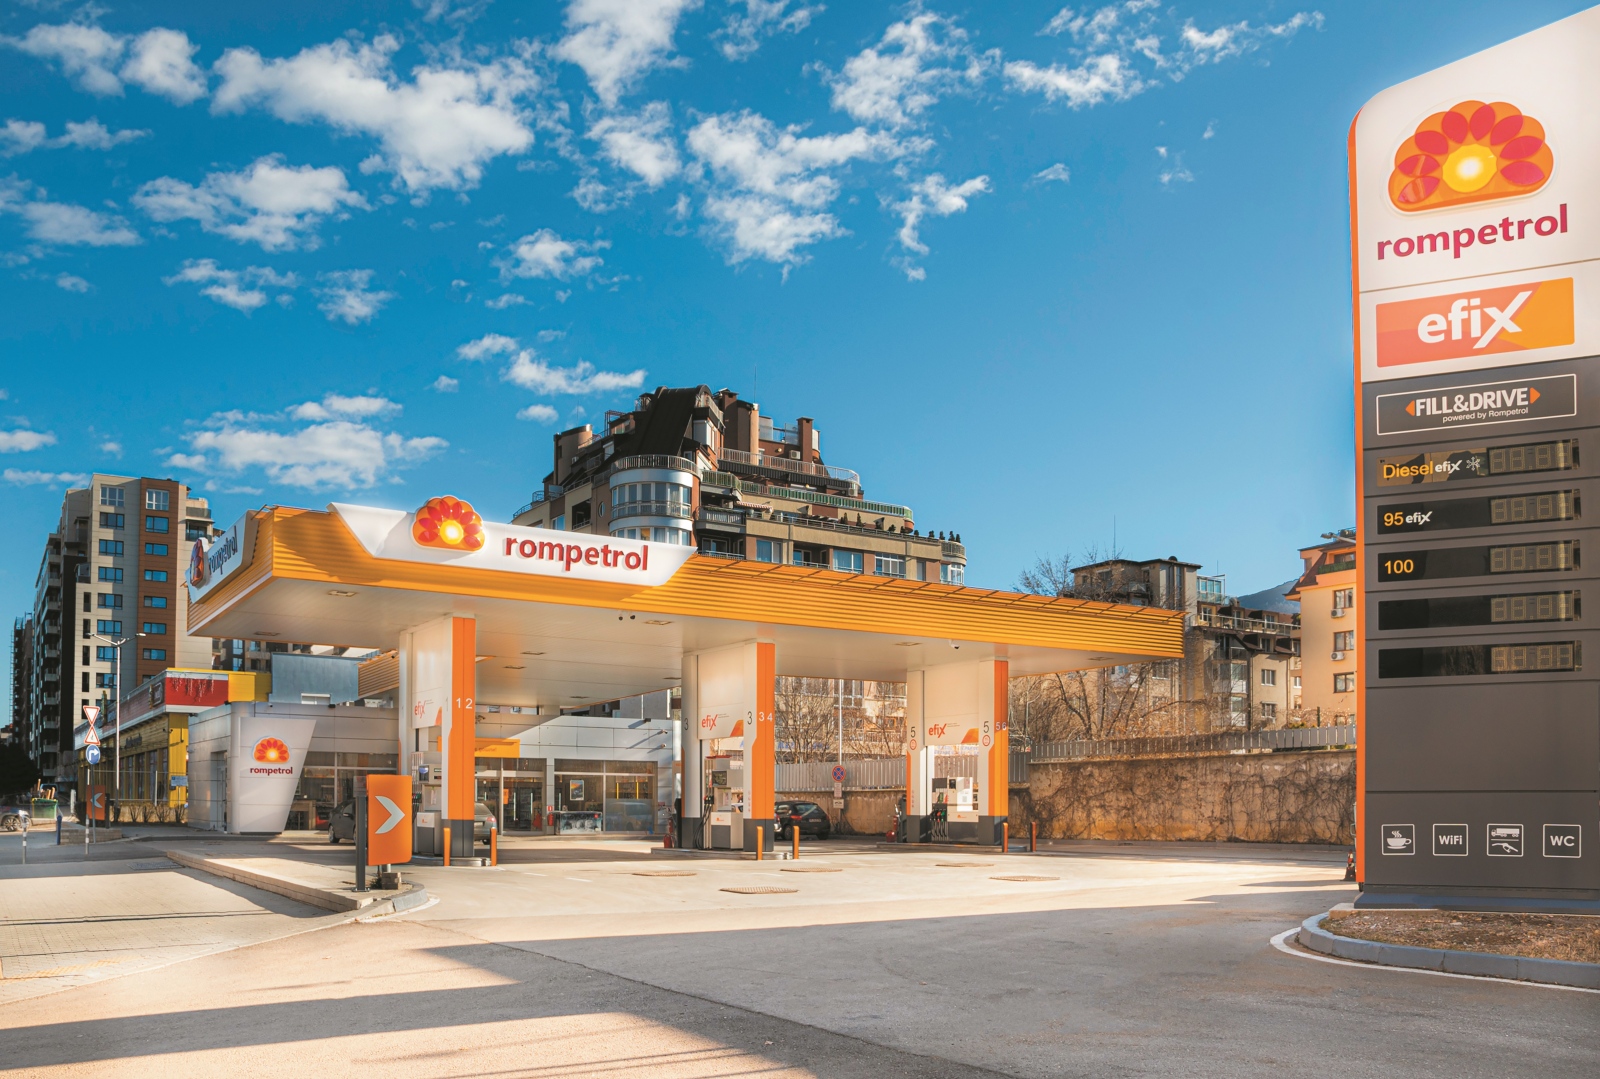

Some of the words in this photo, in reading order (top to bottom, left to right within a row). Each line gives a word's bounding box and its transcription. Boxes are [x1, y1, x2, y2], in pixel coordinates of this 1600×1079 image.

[1377, 203, 1568, 260] rompetrol
[1417, 290, 1533, 349] efix
[1416, 388, 1528, 416] FILL&DRIVE
[1442, 412, 1476, 424] powered
[1477, 410, 1487, 420] by
[1488, 407, 1529, 418] Rompetrol
[1383, 460, 1433, 479] Diesel
[1434, 460, 1463, 474] efix
[1383, 512, 1404, 527] 95
[1405, 511, 1433, 525] efix
[209, 525, 238, 575] rompetrol
[505, 537, 649, 572] rompetrol
[1384, 559, 1414, 575] 100
[456, 698, 461, 708] 1
[465, 698, 473, 709] 2
[684, 718, 689, 730] 3
[701, 714, 718, 730] efix
[747, 711, 753, 725] 3
[759, 712, 765, 721] 3
[767, 713, 773, 721] 4
[910, 726, 916, 738] 5
[928, 723, 947, 738] efix
[983, 721, 989, 733] 5
[996, 722, 1000, 730] 5
[1002, 722, 1007, 730] 6
[249, 766, 293, 776] rompetrol
[1438, 835, 1463, 845] WiFi
[1549, 835, 1575, 847] WC
